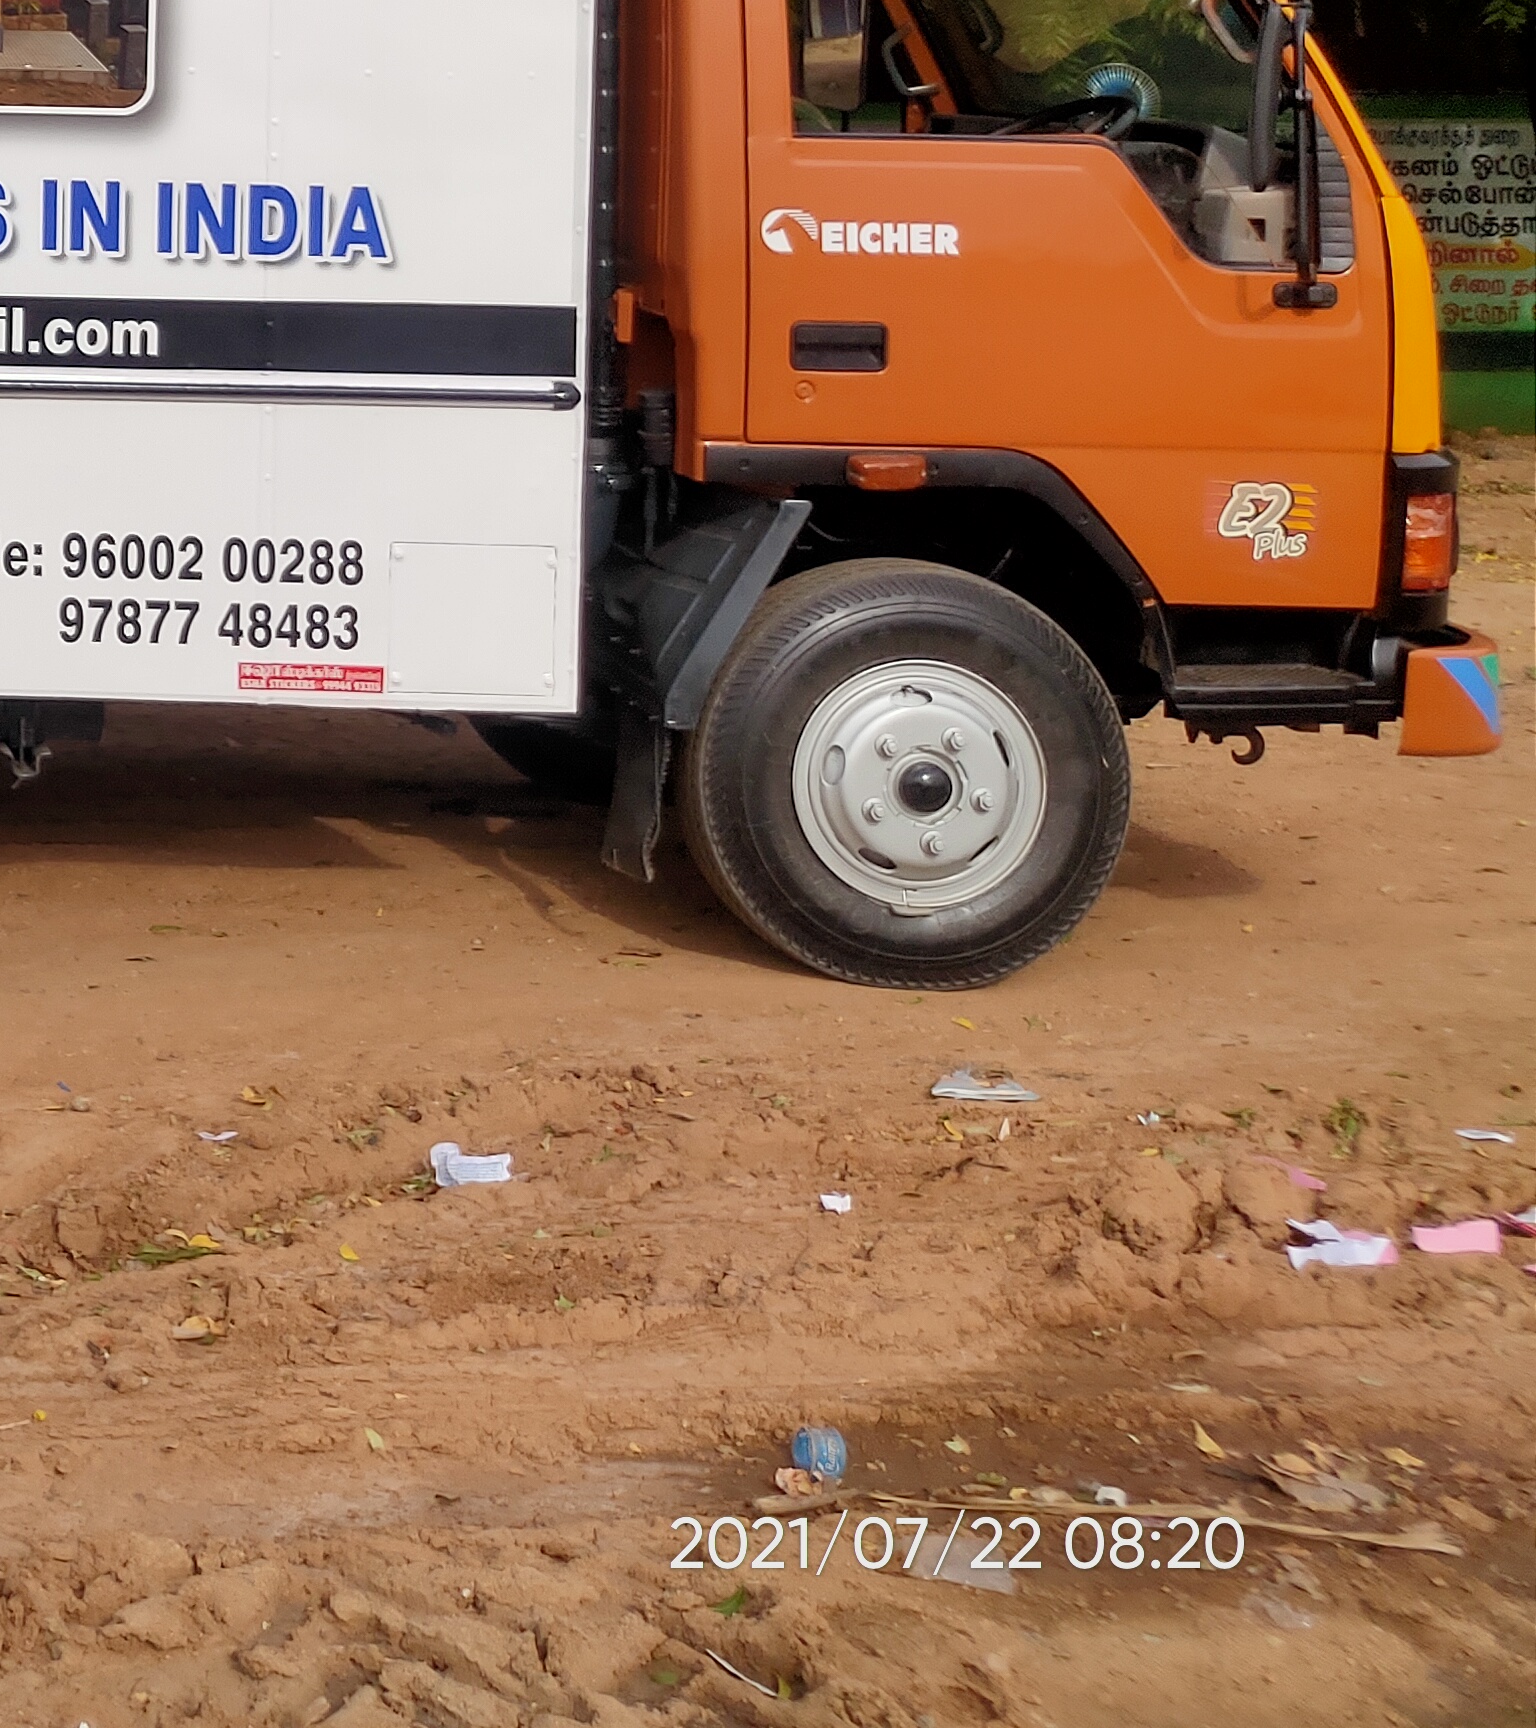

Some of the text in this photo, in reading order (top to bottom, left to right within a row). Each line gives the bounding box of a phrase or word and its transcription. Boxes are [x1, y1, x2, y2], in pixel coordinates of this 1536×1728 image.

[1386, 151, 1460, 177] கனம்
[41, 178, 121, 253] IN
[156, 182, 389, 258] INDIA
[822, 221, 960, 256] EICHER
[63, 532, 204, 581] 96002
[222, 537, 364, 586] 00288
[59, 597, 359, 651] 97877 48483
